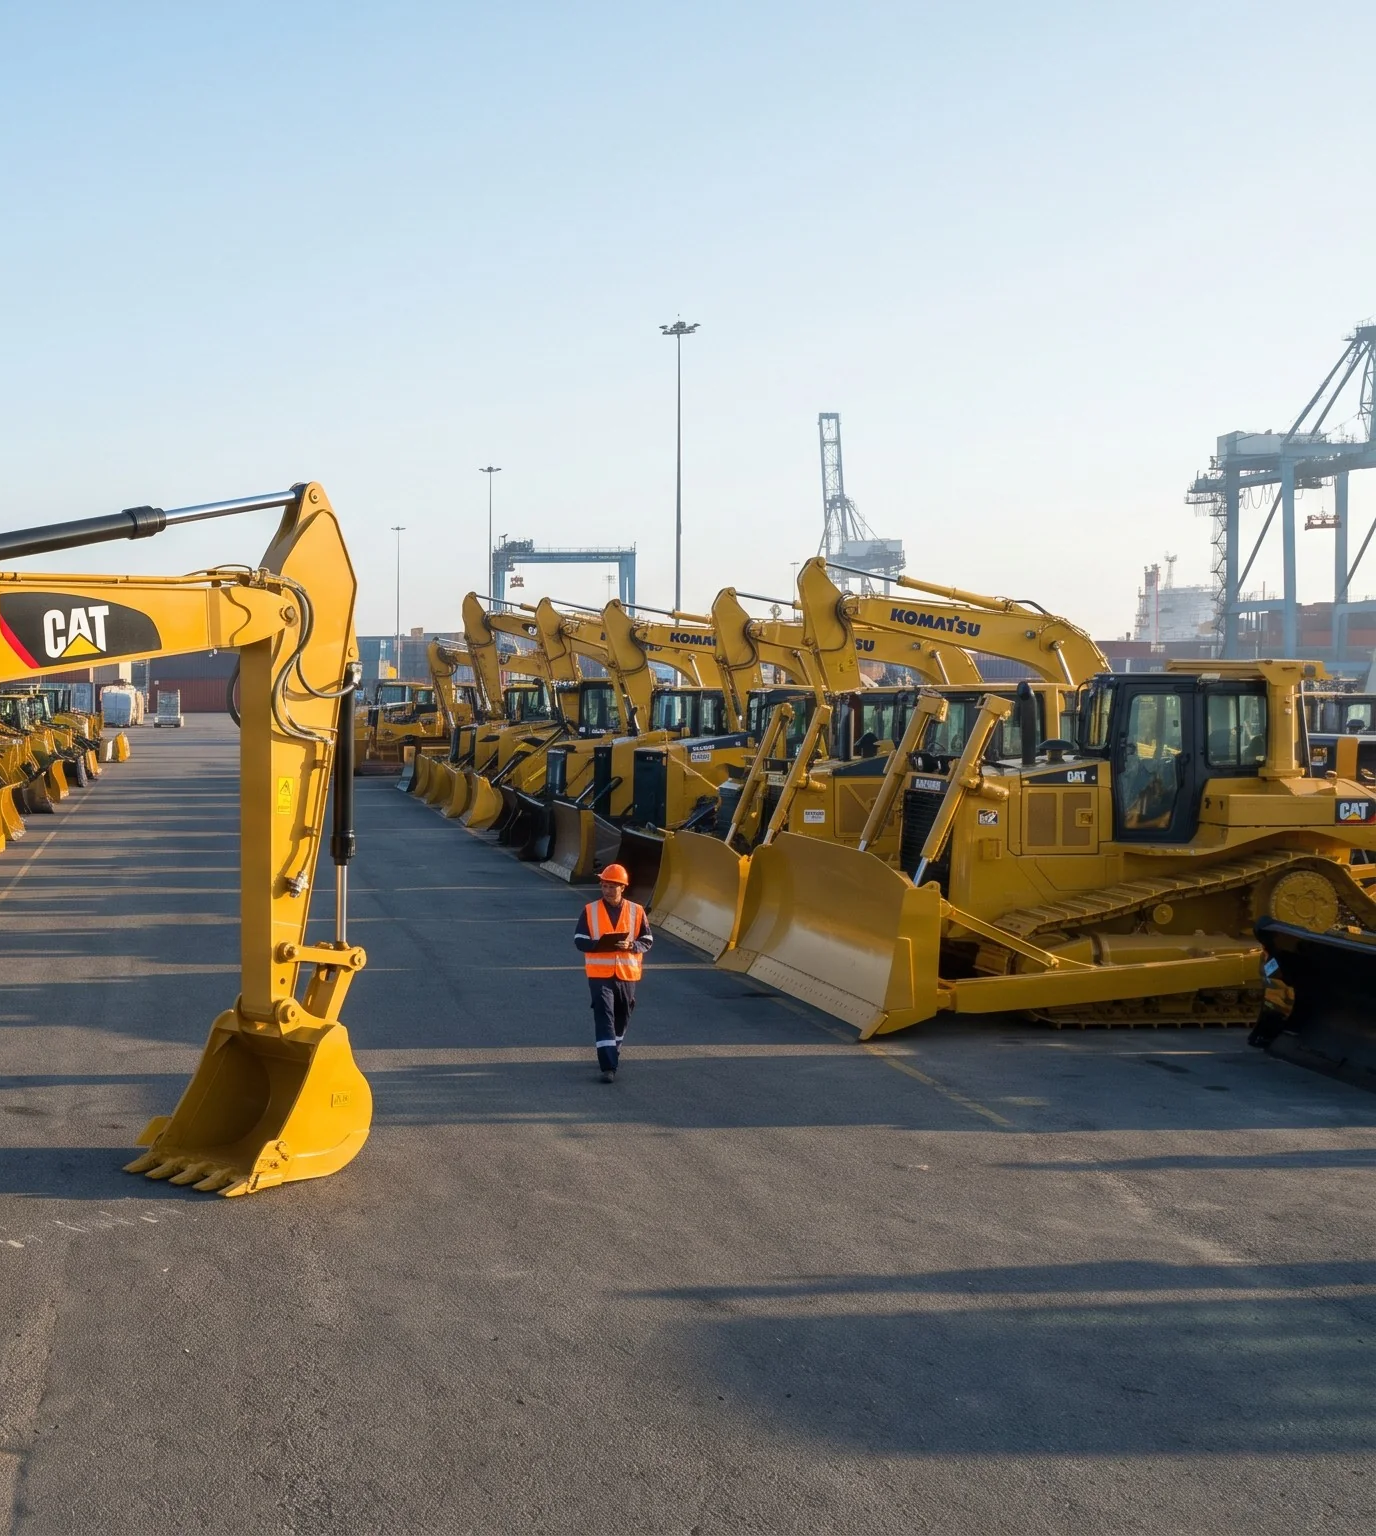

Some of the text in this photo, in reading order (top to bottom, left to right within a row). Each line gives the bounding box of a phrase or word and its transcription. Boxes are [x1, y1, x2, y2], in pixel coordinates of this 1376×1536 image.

[43, 605, 110, 659] CAT
[889, 607, 981, 637] KOMATSU
[1339, 802, 1369, 820] CAT
